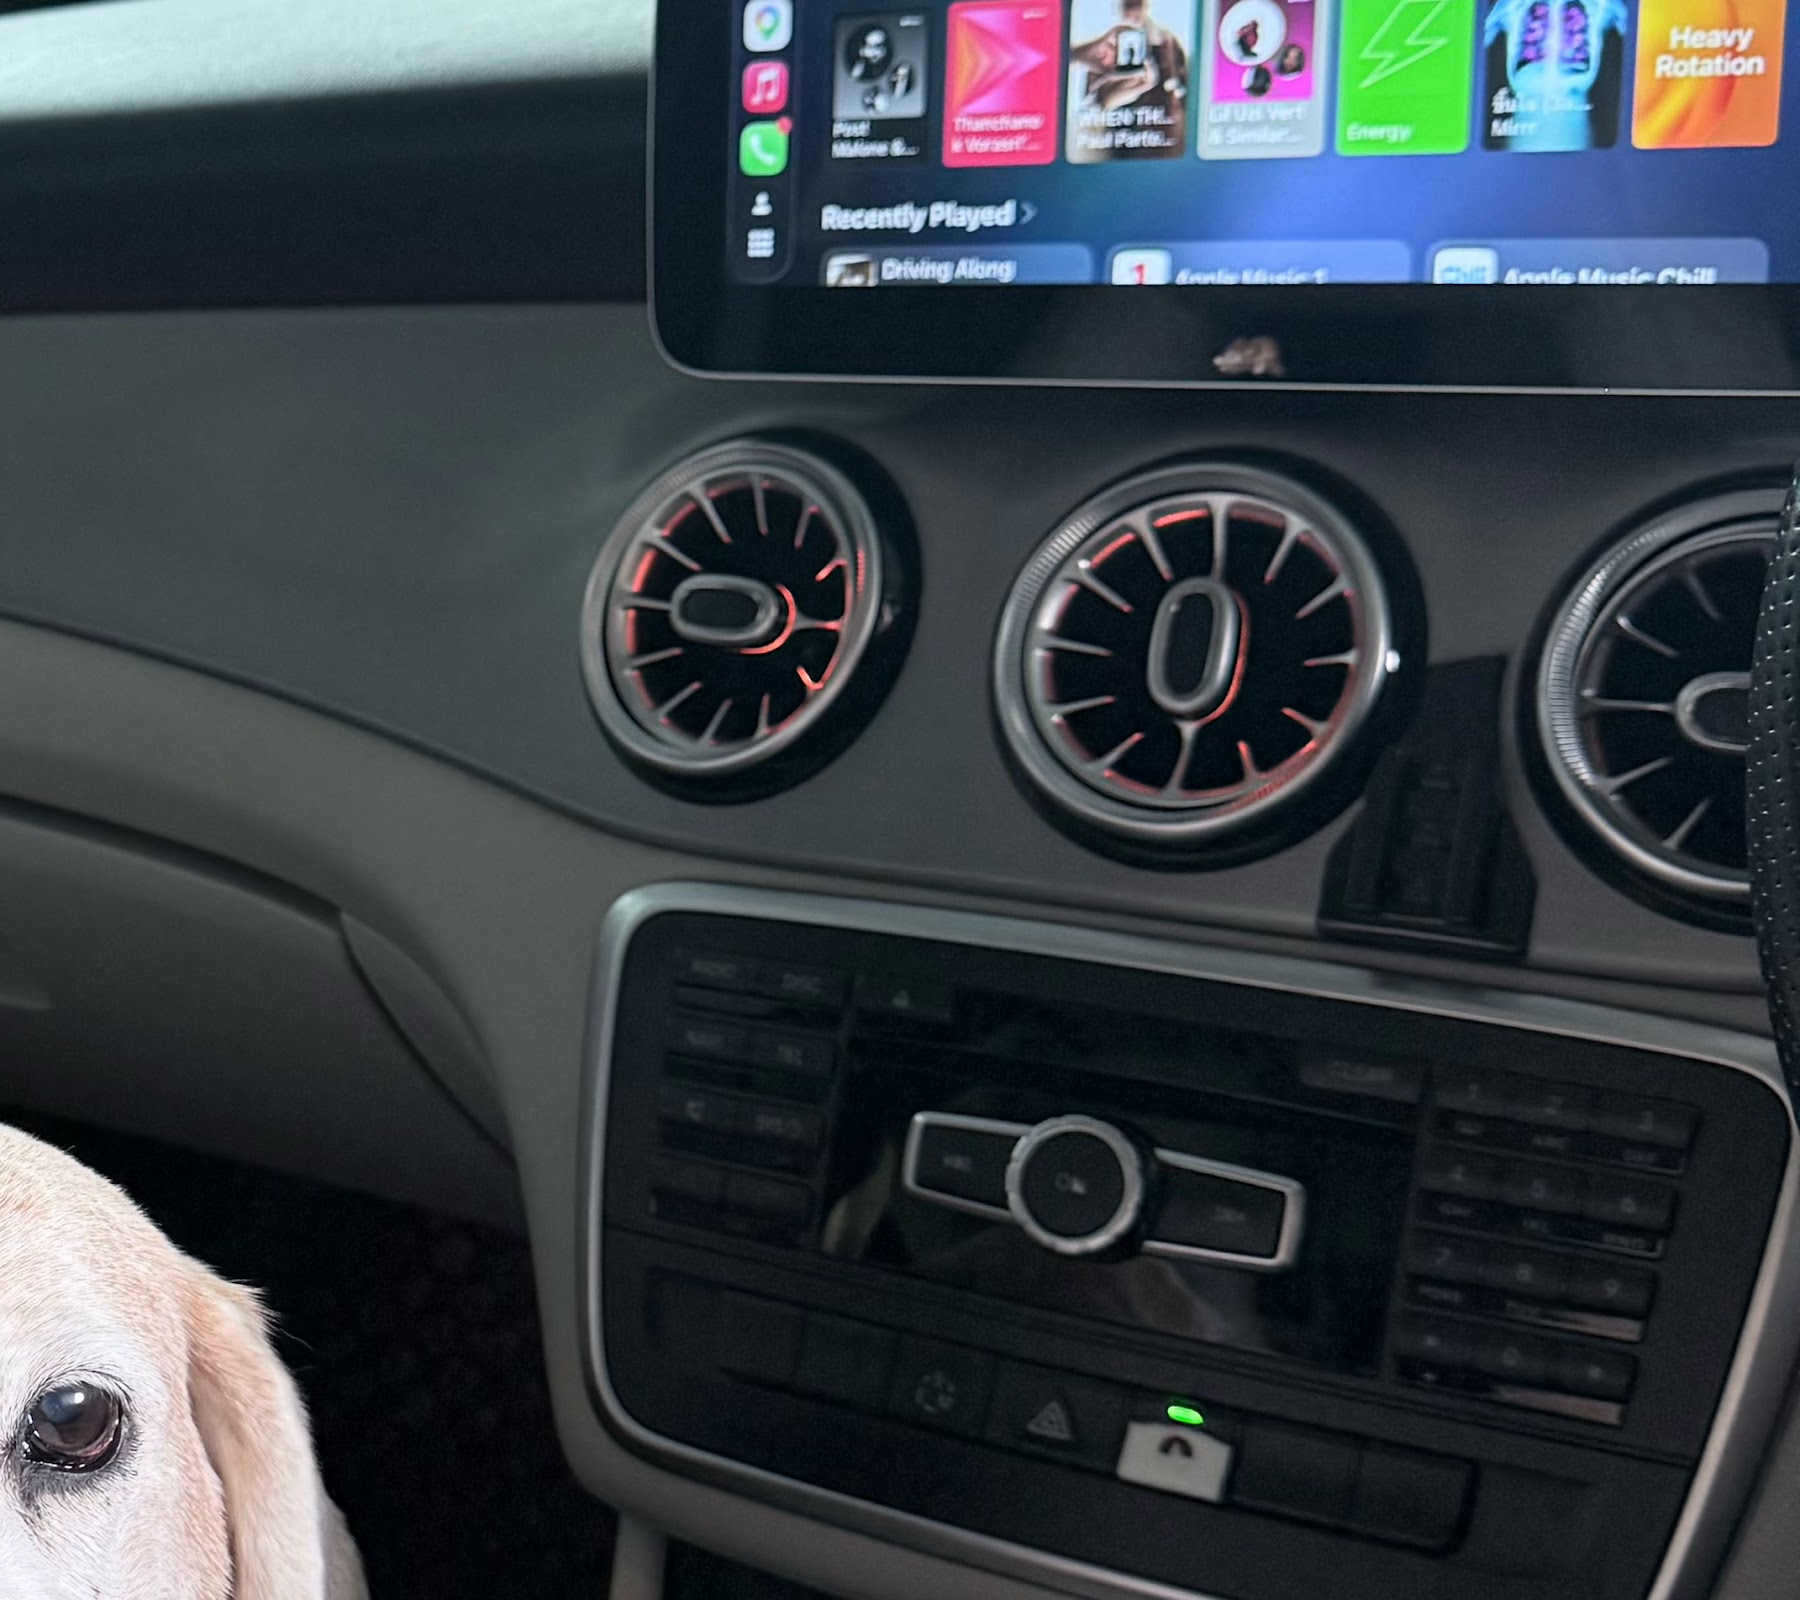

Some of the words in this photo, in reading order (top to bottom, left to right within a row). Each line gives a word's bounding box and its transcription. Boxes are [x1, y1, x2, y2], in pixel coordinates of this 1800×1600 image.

[1669, 24, 1755, 54] Heavy
[1655, 51, 1766, 79] Rotation
[1346, 121, 1414, 144] Energy
[821, 201, 929, 234] Recently
[929, 198, 1017, 232] Played
[881, 257, 955, 284] Driving
[955, 257, 1018, 283] Along
[1656, 267, 1719, 284] Chill
